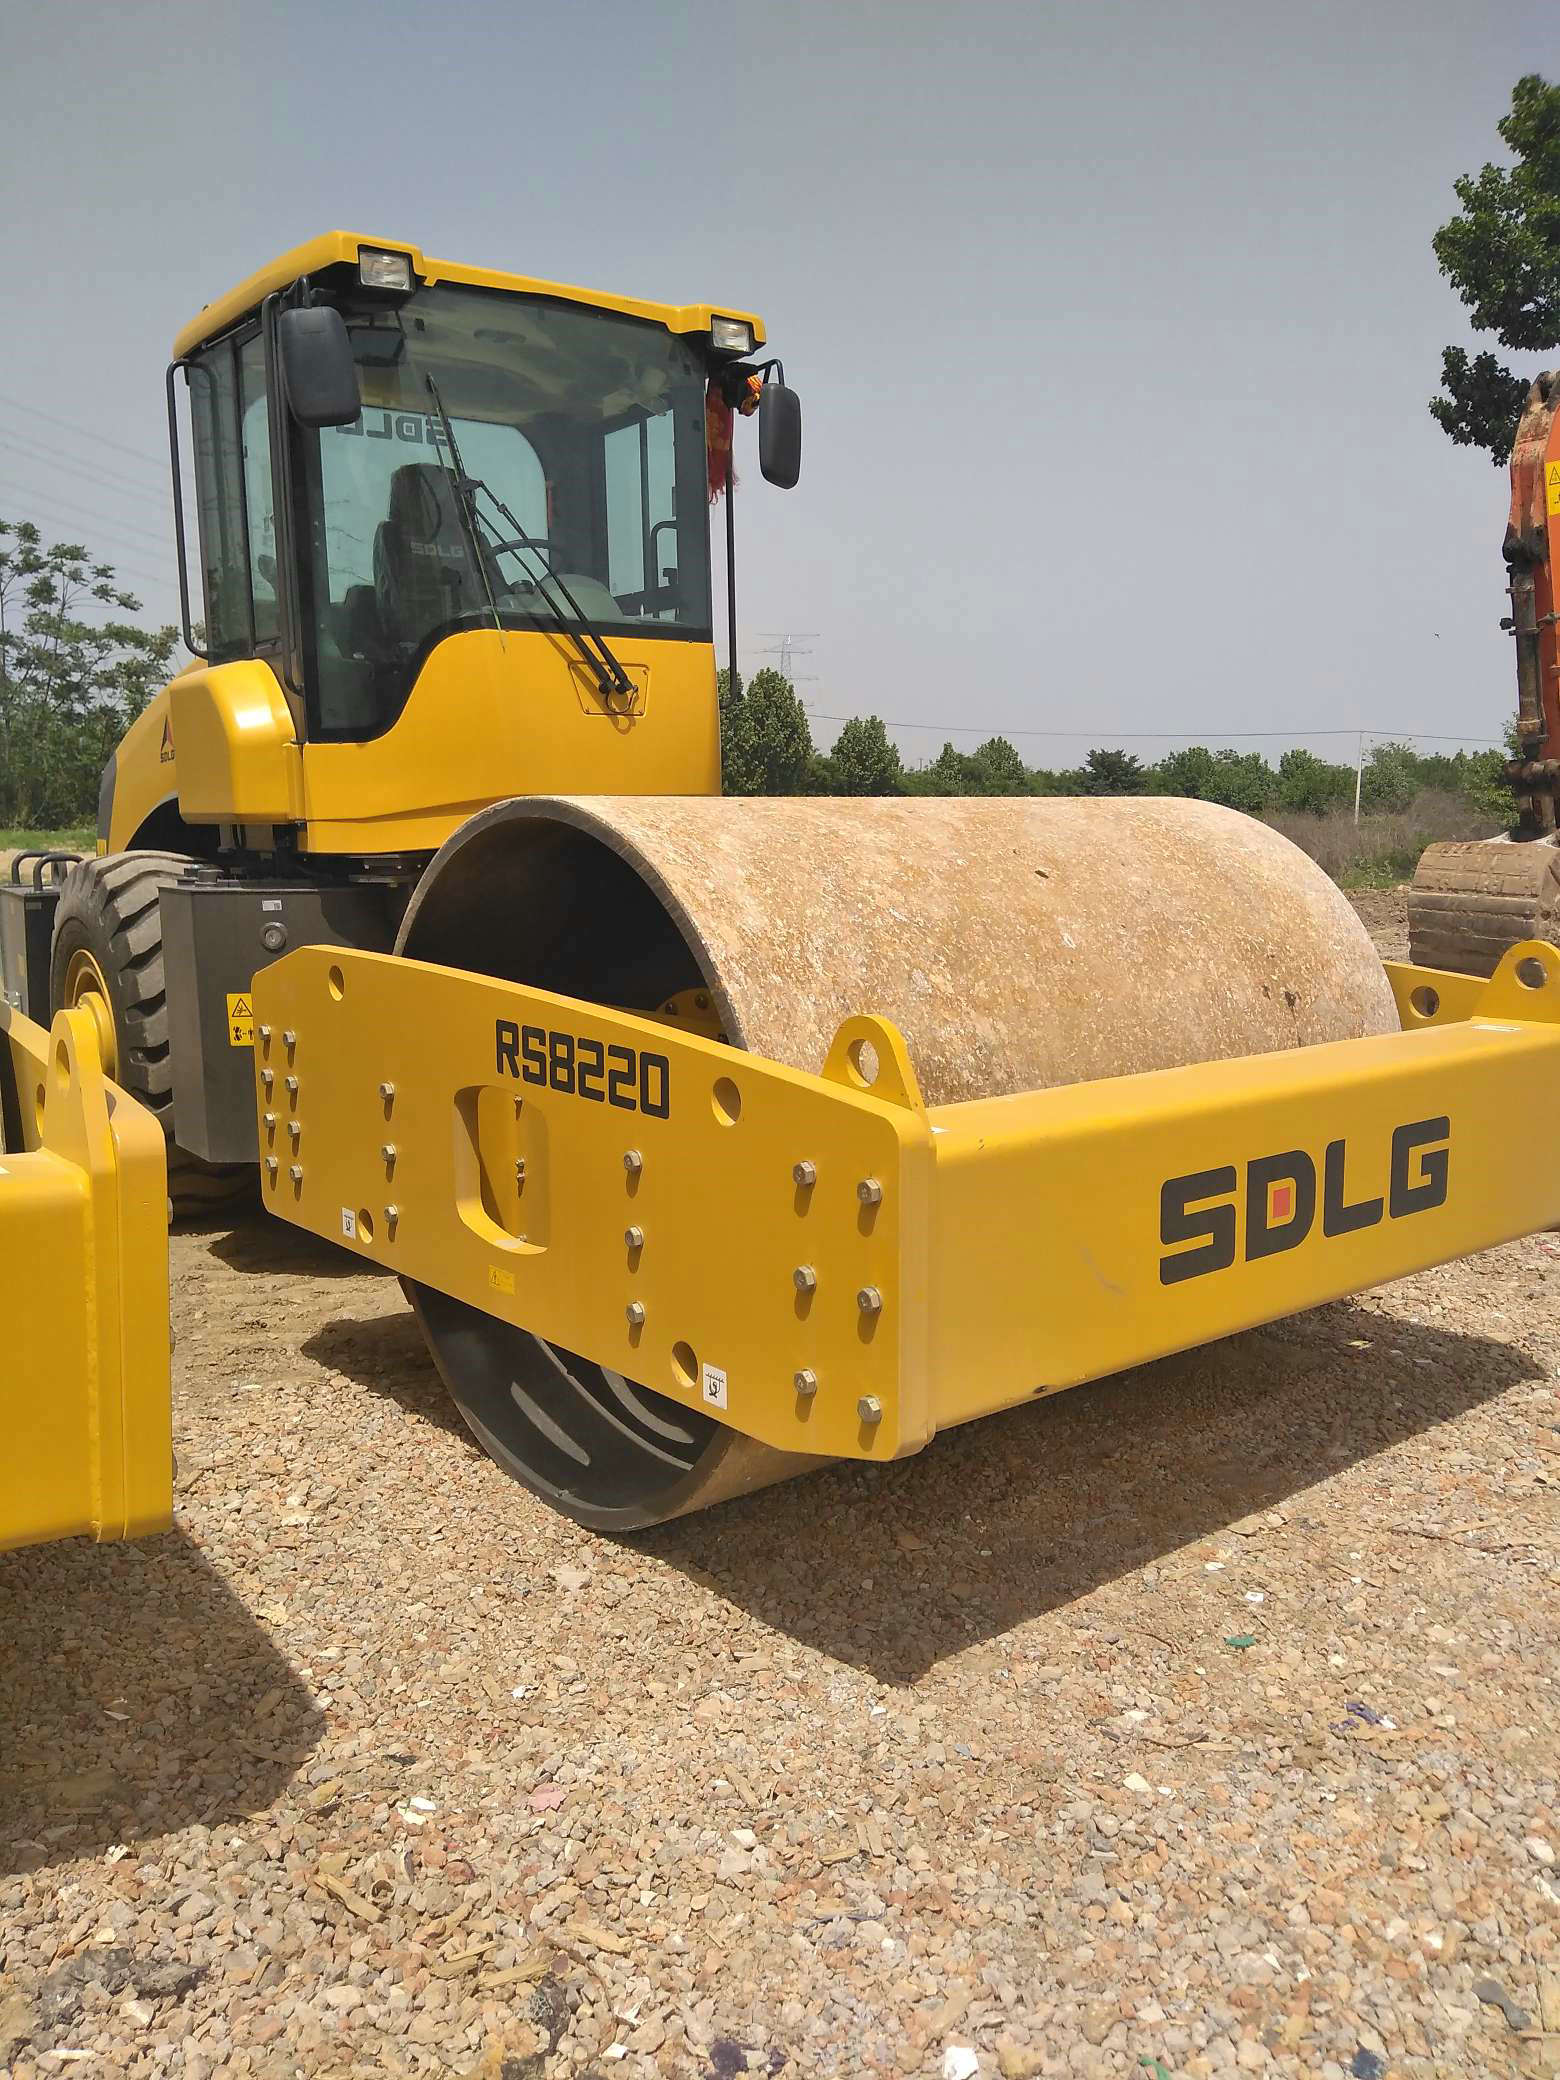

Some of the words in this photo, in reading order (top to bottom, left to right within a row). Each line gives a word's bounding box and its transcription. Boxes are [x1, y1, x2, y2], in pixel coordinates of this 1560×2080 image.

[410, 542, 465, 558] SDLG
[495, 1019, 670, 1120] RS8220
[1160, 1115, 1450, 1285] SDLG
